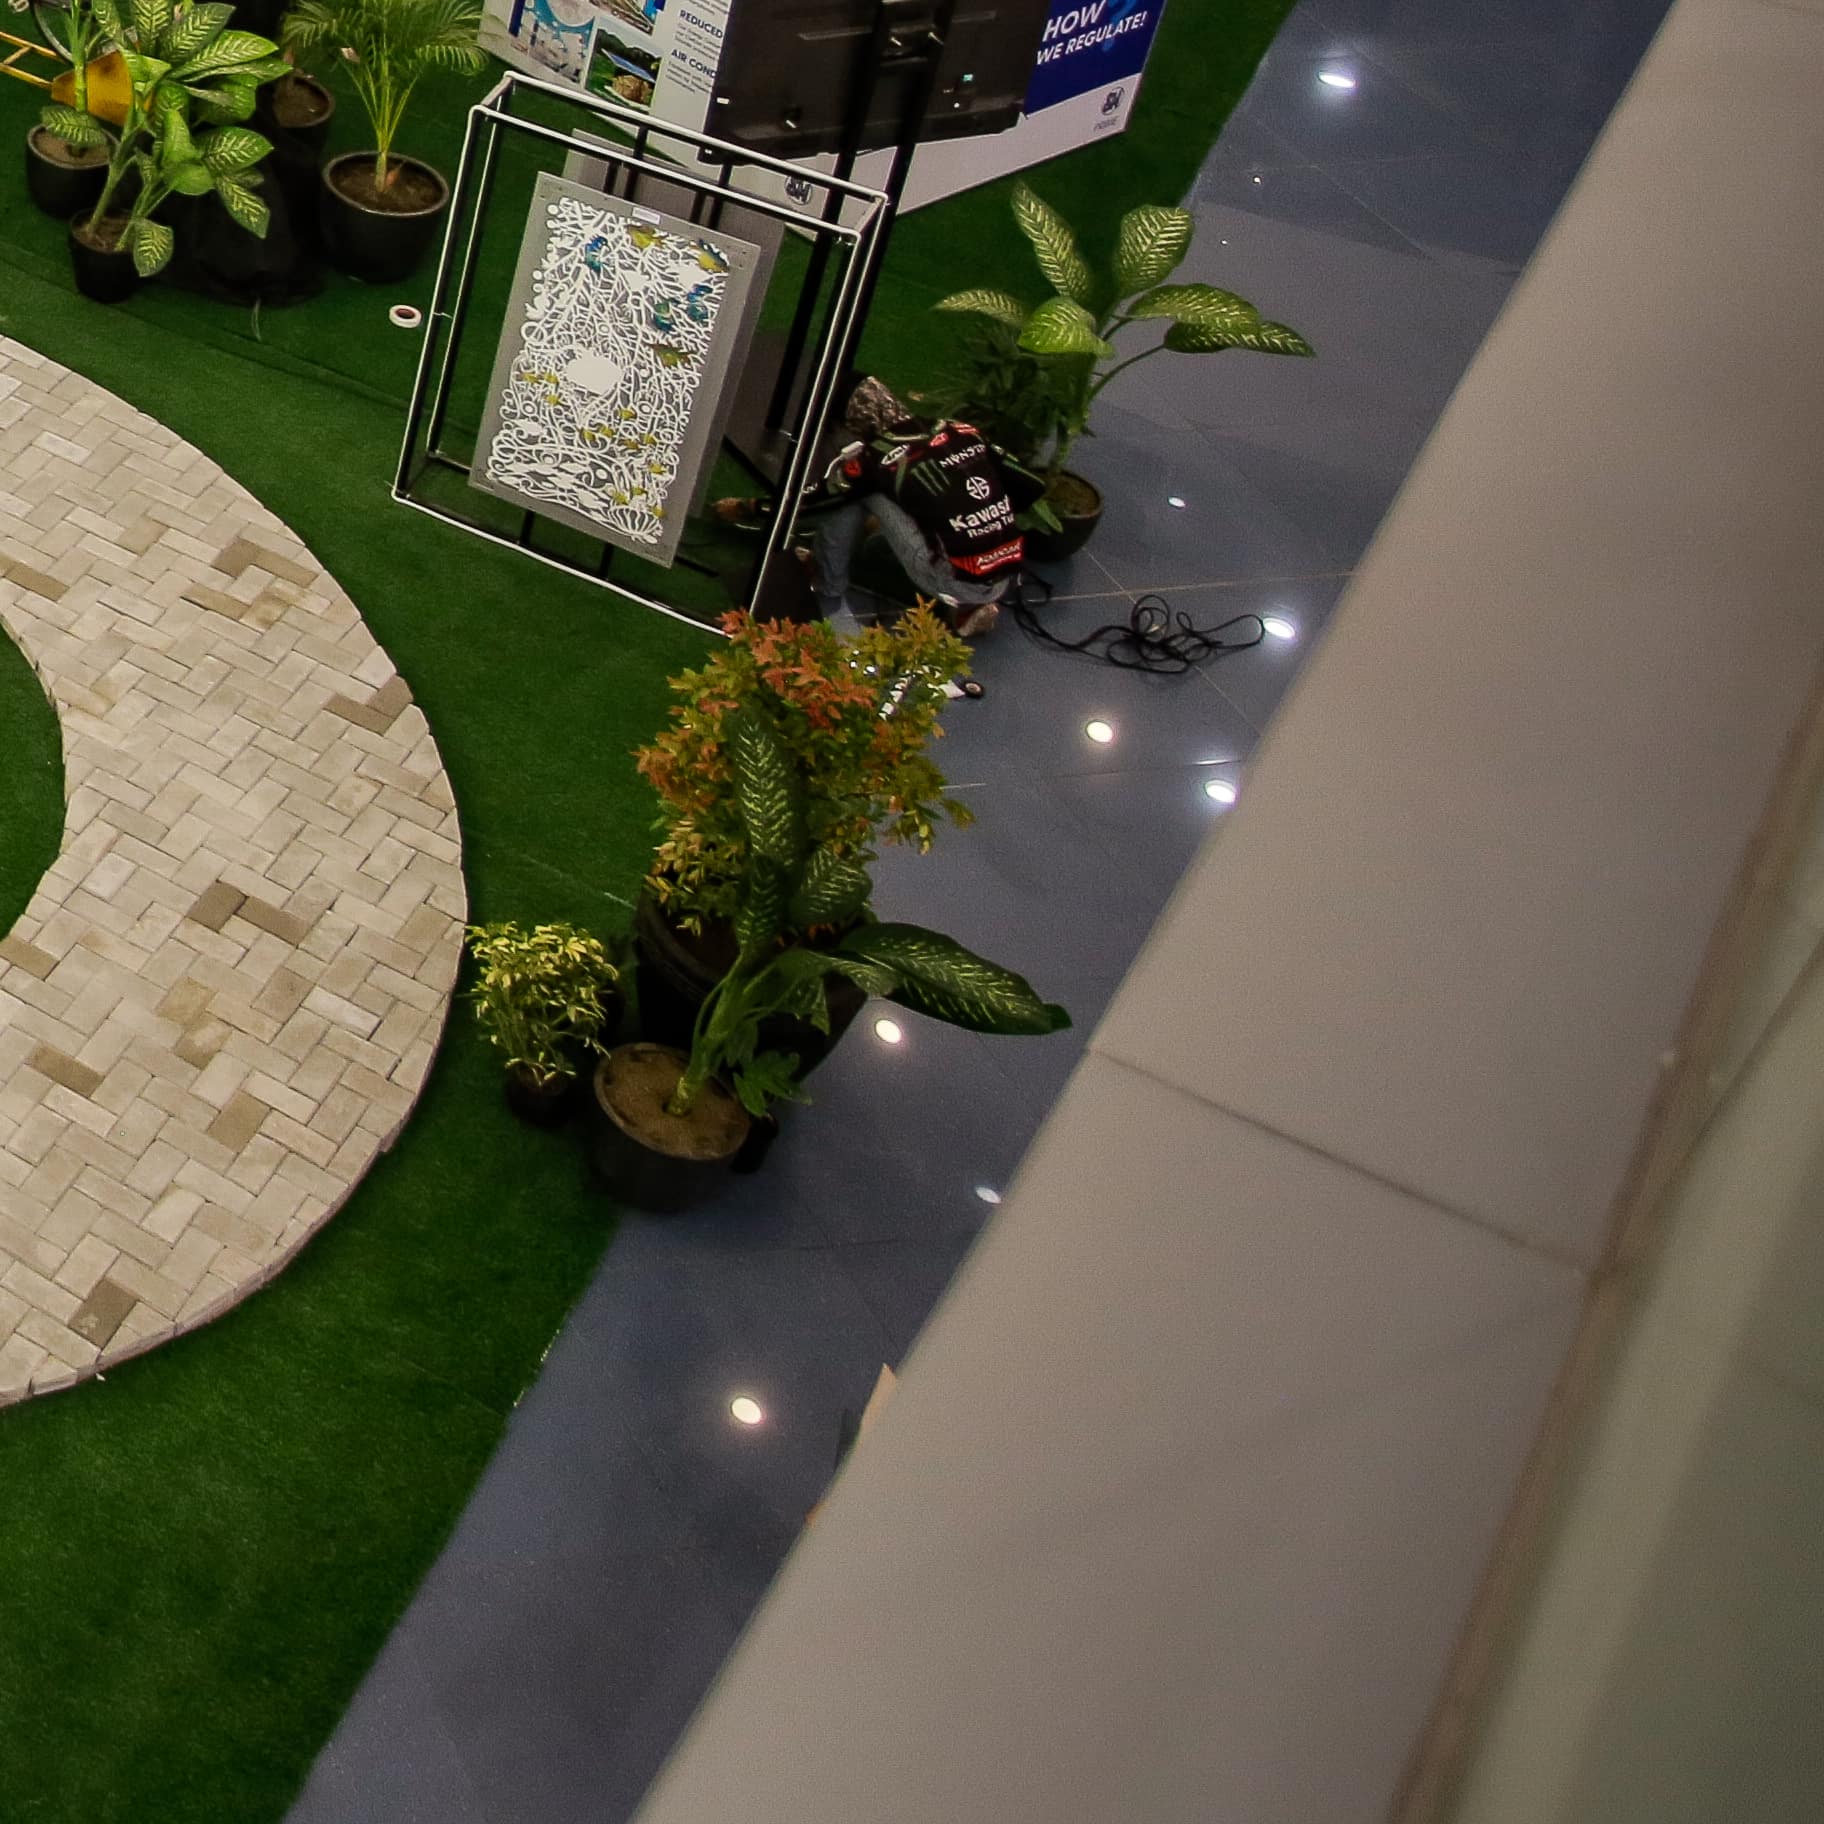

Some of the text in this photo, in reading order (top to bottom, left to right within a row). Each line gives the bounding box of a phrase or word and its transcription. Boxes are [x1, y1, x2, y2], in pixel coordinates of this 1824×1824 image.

[680, 9, 723, 39] REDUCED
[1036, 11, 1148, 65] WE REGULATE!
[1042, 0, 1106, 42] HOW
[671, 48, 688, 64] AIR
